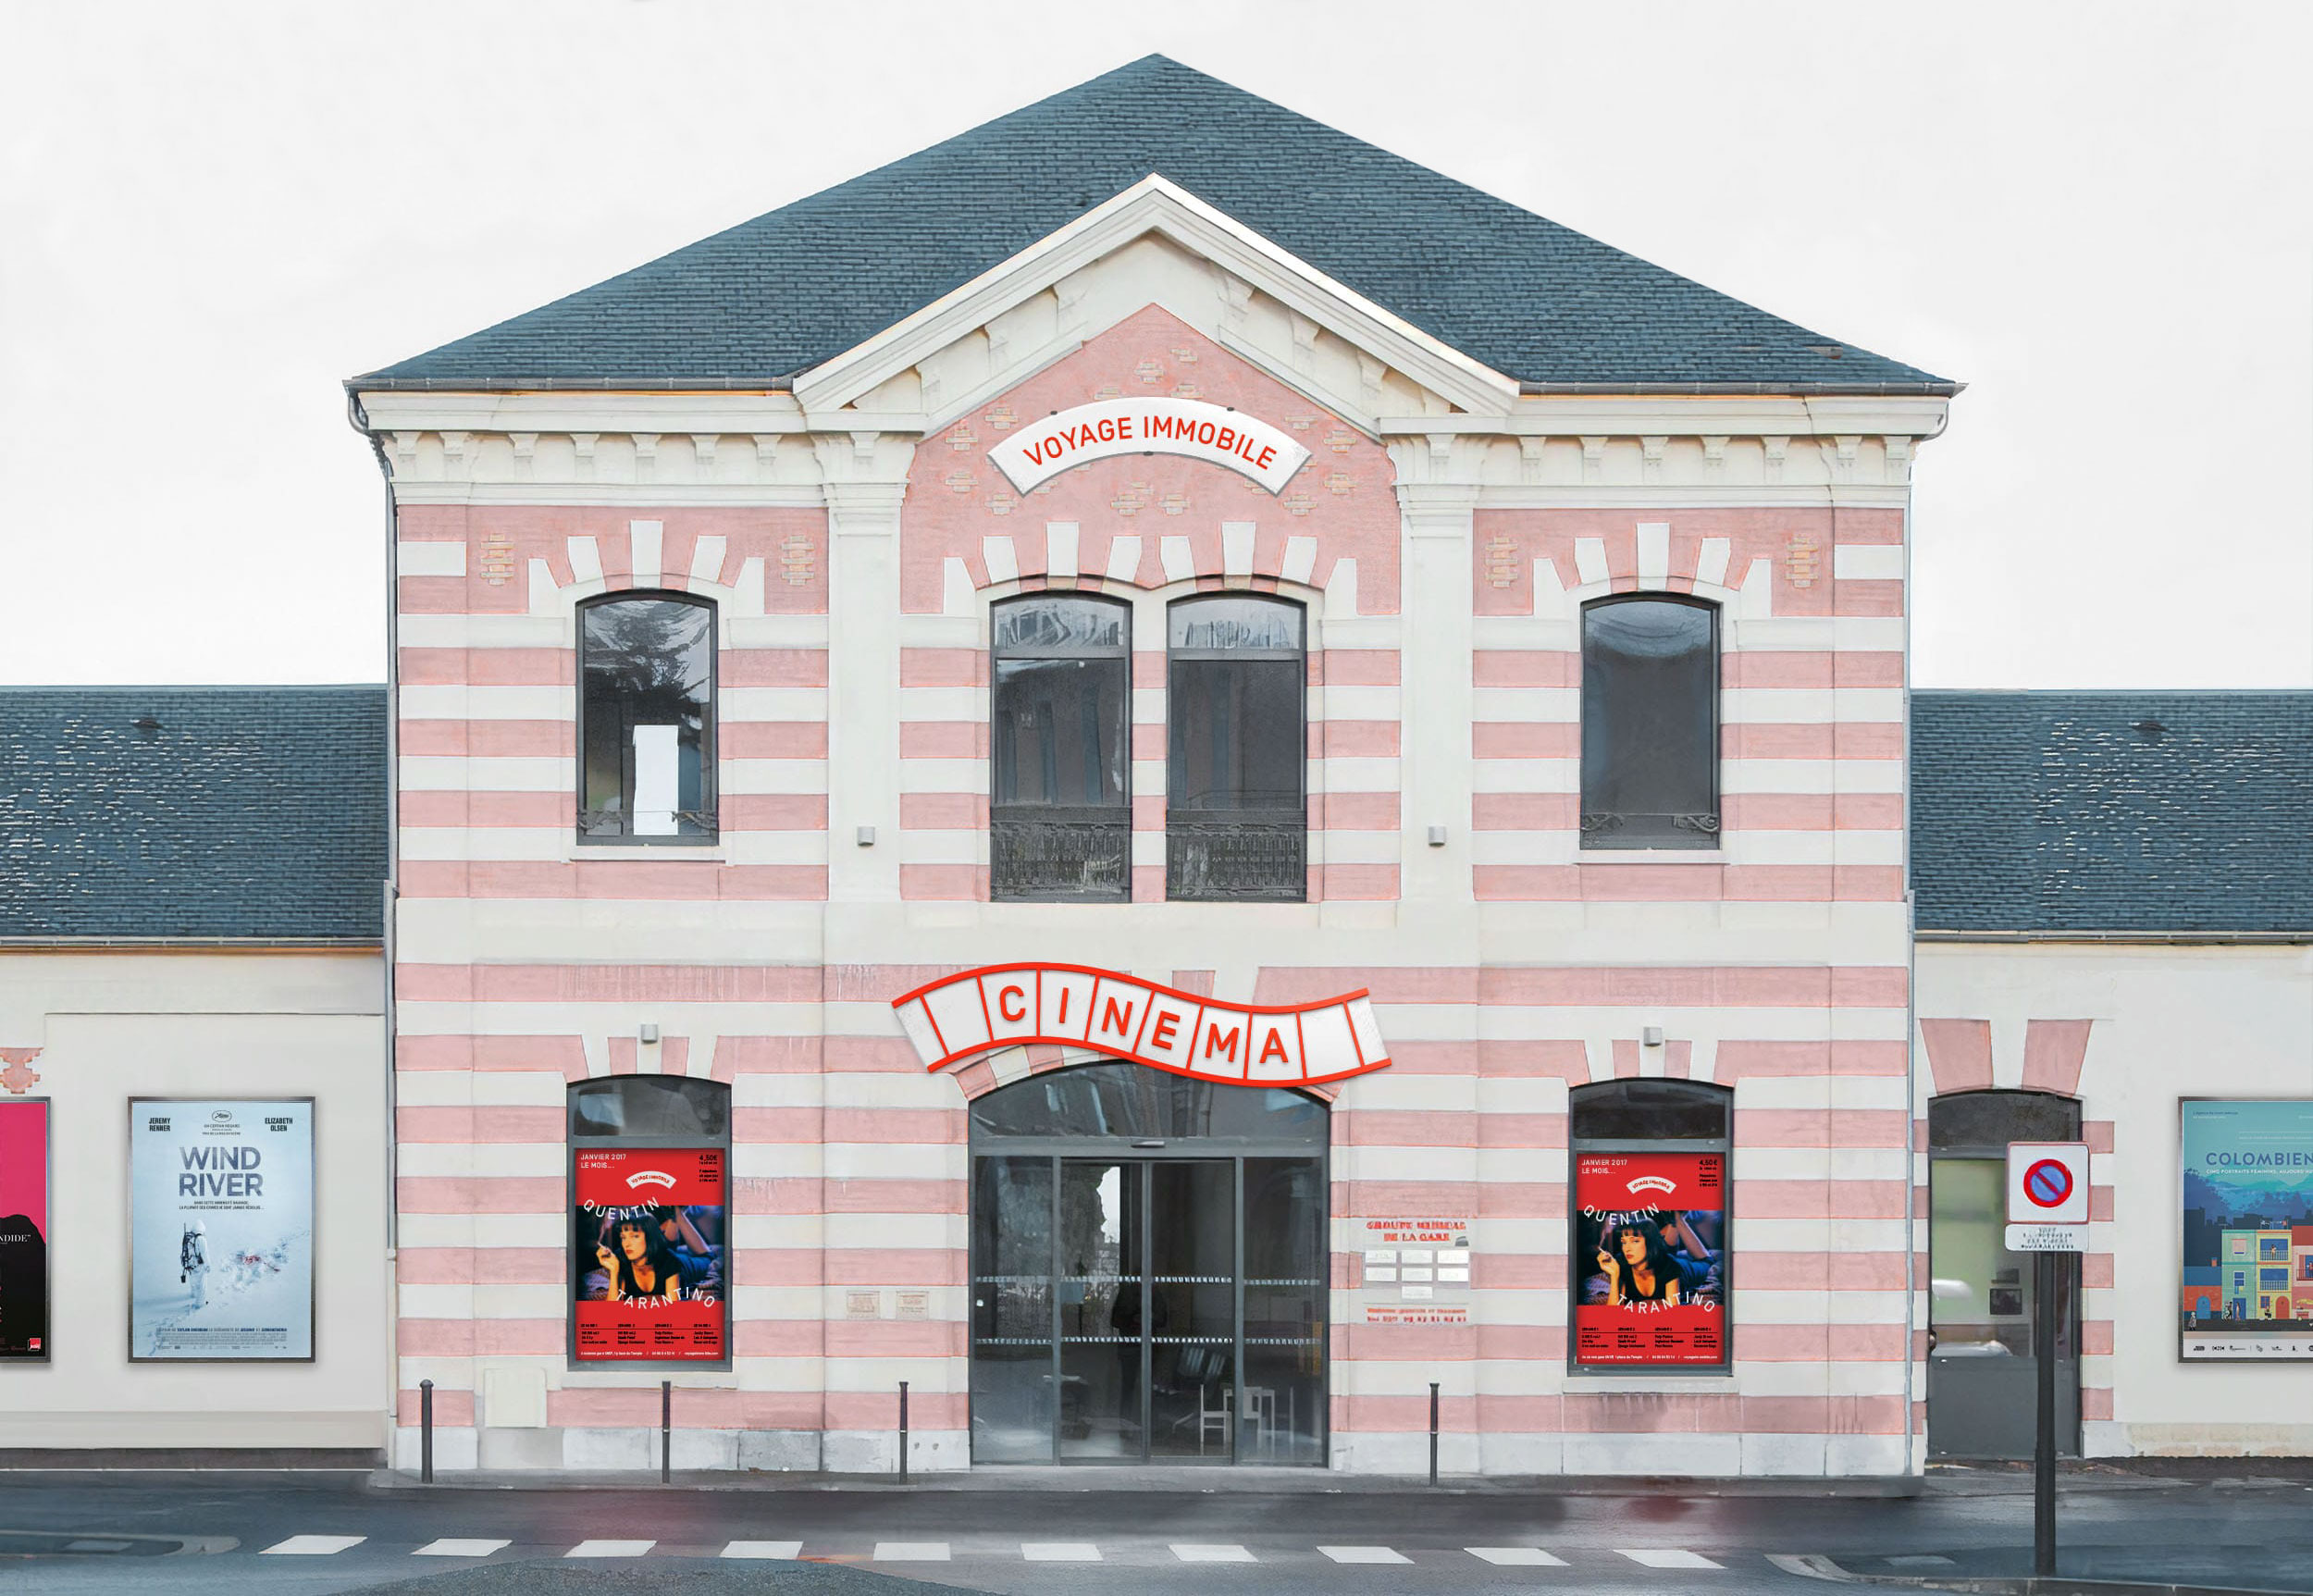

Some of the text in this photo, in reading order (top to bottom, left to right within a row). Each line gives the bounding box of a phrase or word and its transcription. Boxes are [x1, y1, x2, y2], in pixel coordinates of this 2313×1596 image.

[1022, 415, 1278, 470] VOYAGE IMMOBILE
[999, 984, 1289, 1064] CINEMA
[179, 1146, 262, 1170] WIND
[179, 1173, 264, 1197] RIVER
[584, 1196, 660, 1221] QUENTIN
[1583, 1202, 1660, 1226] QUENTIN
[1402, 1233, 1417, 1242] LA
[616, 1286, 716, 1310] TARANTINO
[1617, 1291, 1715, 1314] TARANTINO
